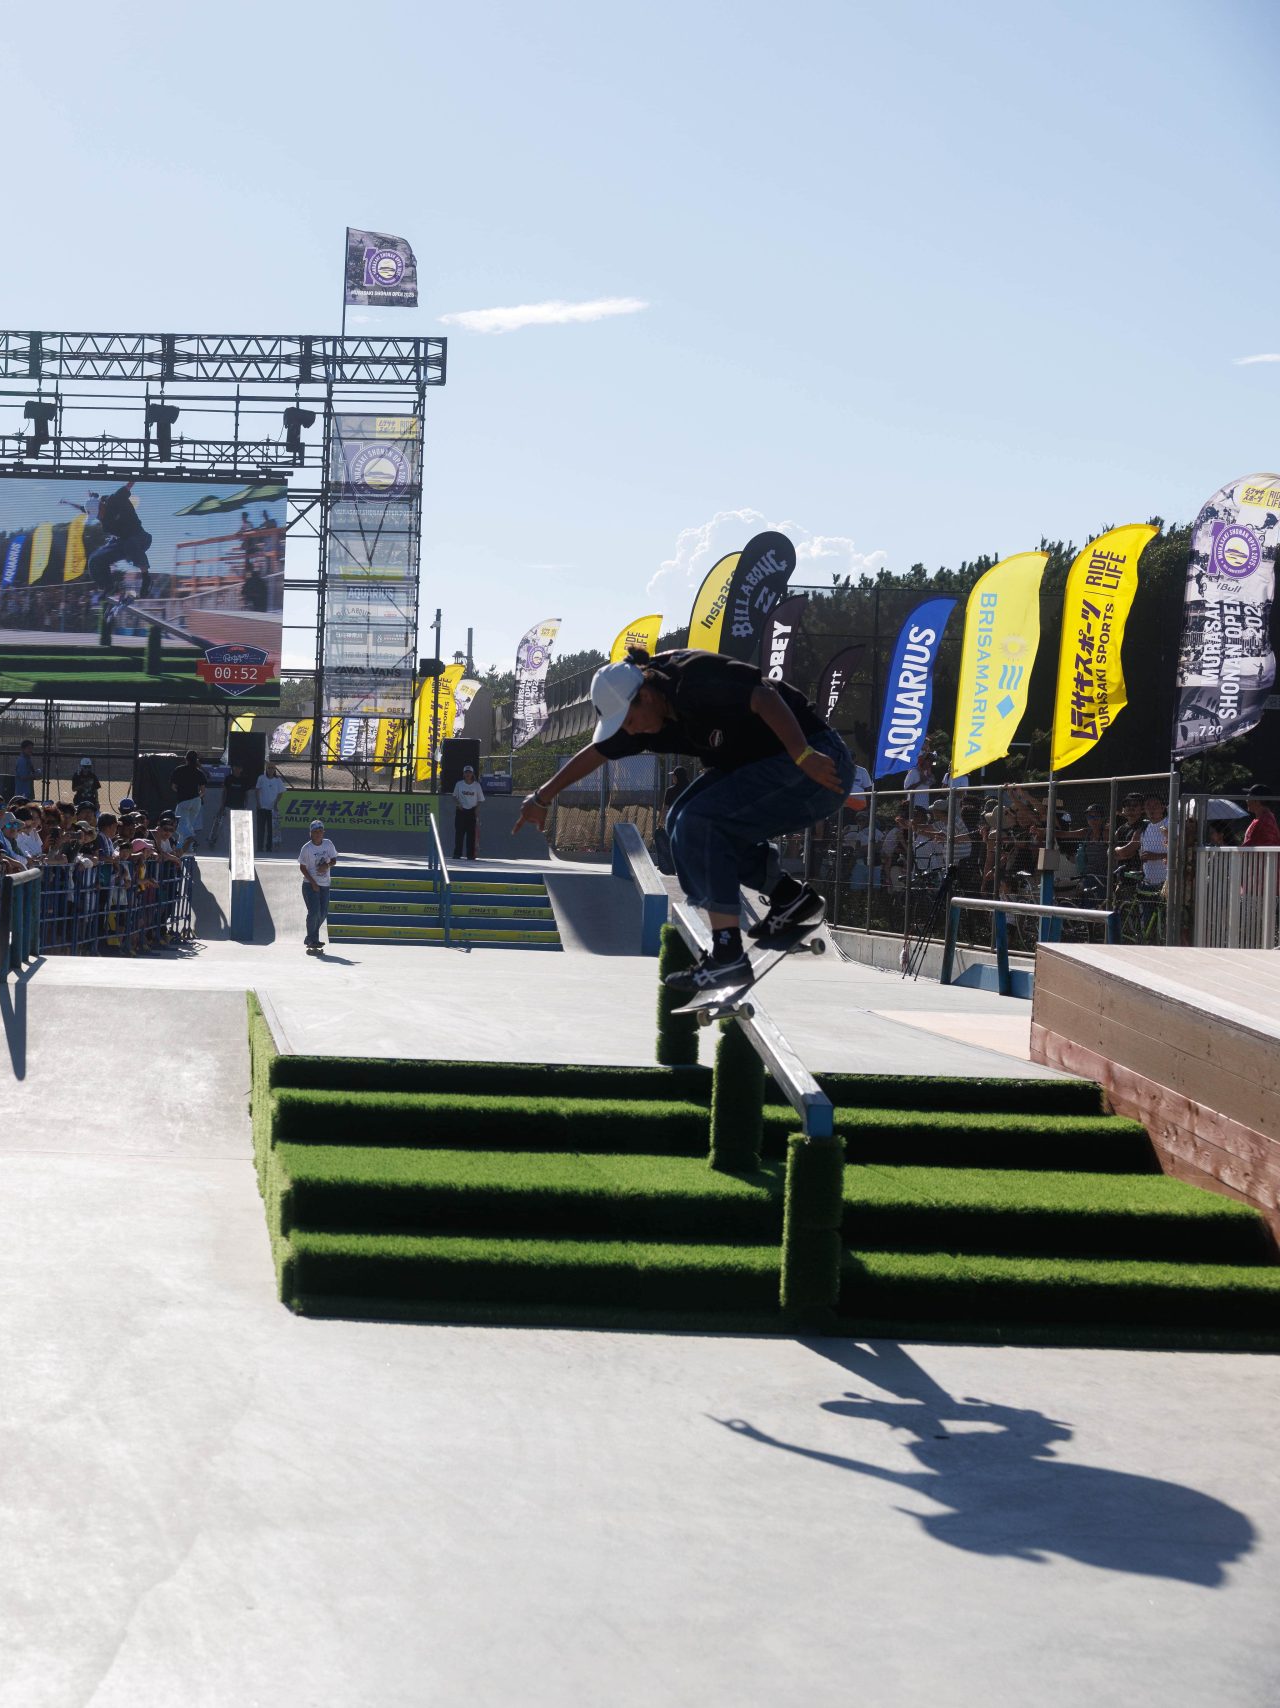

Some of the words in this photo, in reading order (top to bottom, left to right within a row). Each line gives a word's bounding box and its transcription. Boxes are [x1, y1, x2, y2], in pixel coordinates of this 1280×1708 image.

[1086, 549, 1110, 587] RIDE
[1102, 553, 1127, 589] LIFE
[347, 587, 394, 600] AQUARIUS
[732, 550, 788, 638] BILLABONG
[1096, 603, 1114, 666] SPORTS
[214, 667, 258, 680] 00:52
[370, 667, 401, 677] VANS
[964, 592, 998, 758] BRISAMARINA
[1070, 598, 1102, 741] ムラサキスポーツ
[441, 677, 452, 696] LIFE
[884, 625, 936, 763] AQUARIUS
[1095, 668, 1110, 733] URASAKI
[286, 800, 394, 818] ムラサキスポーツ
[347, 817, 394, 826] SPORTS
[404, 803, 431, 815] RIDE
[404, 815, 431, 827] LIFE
